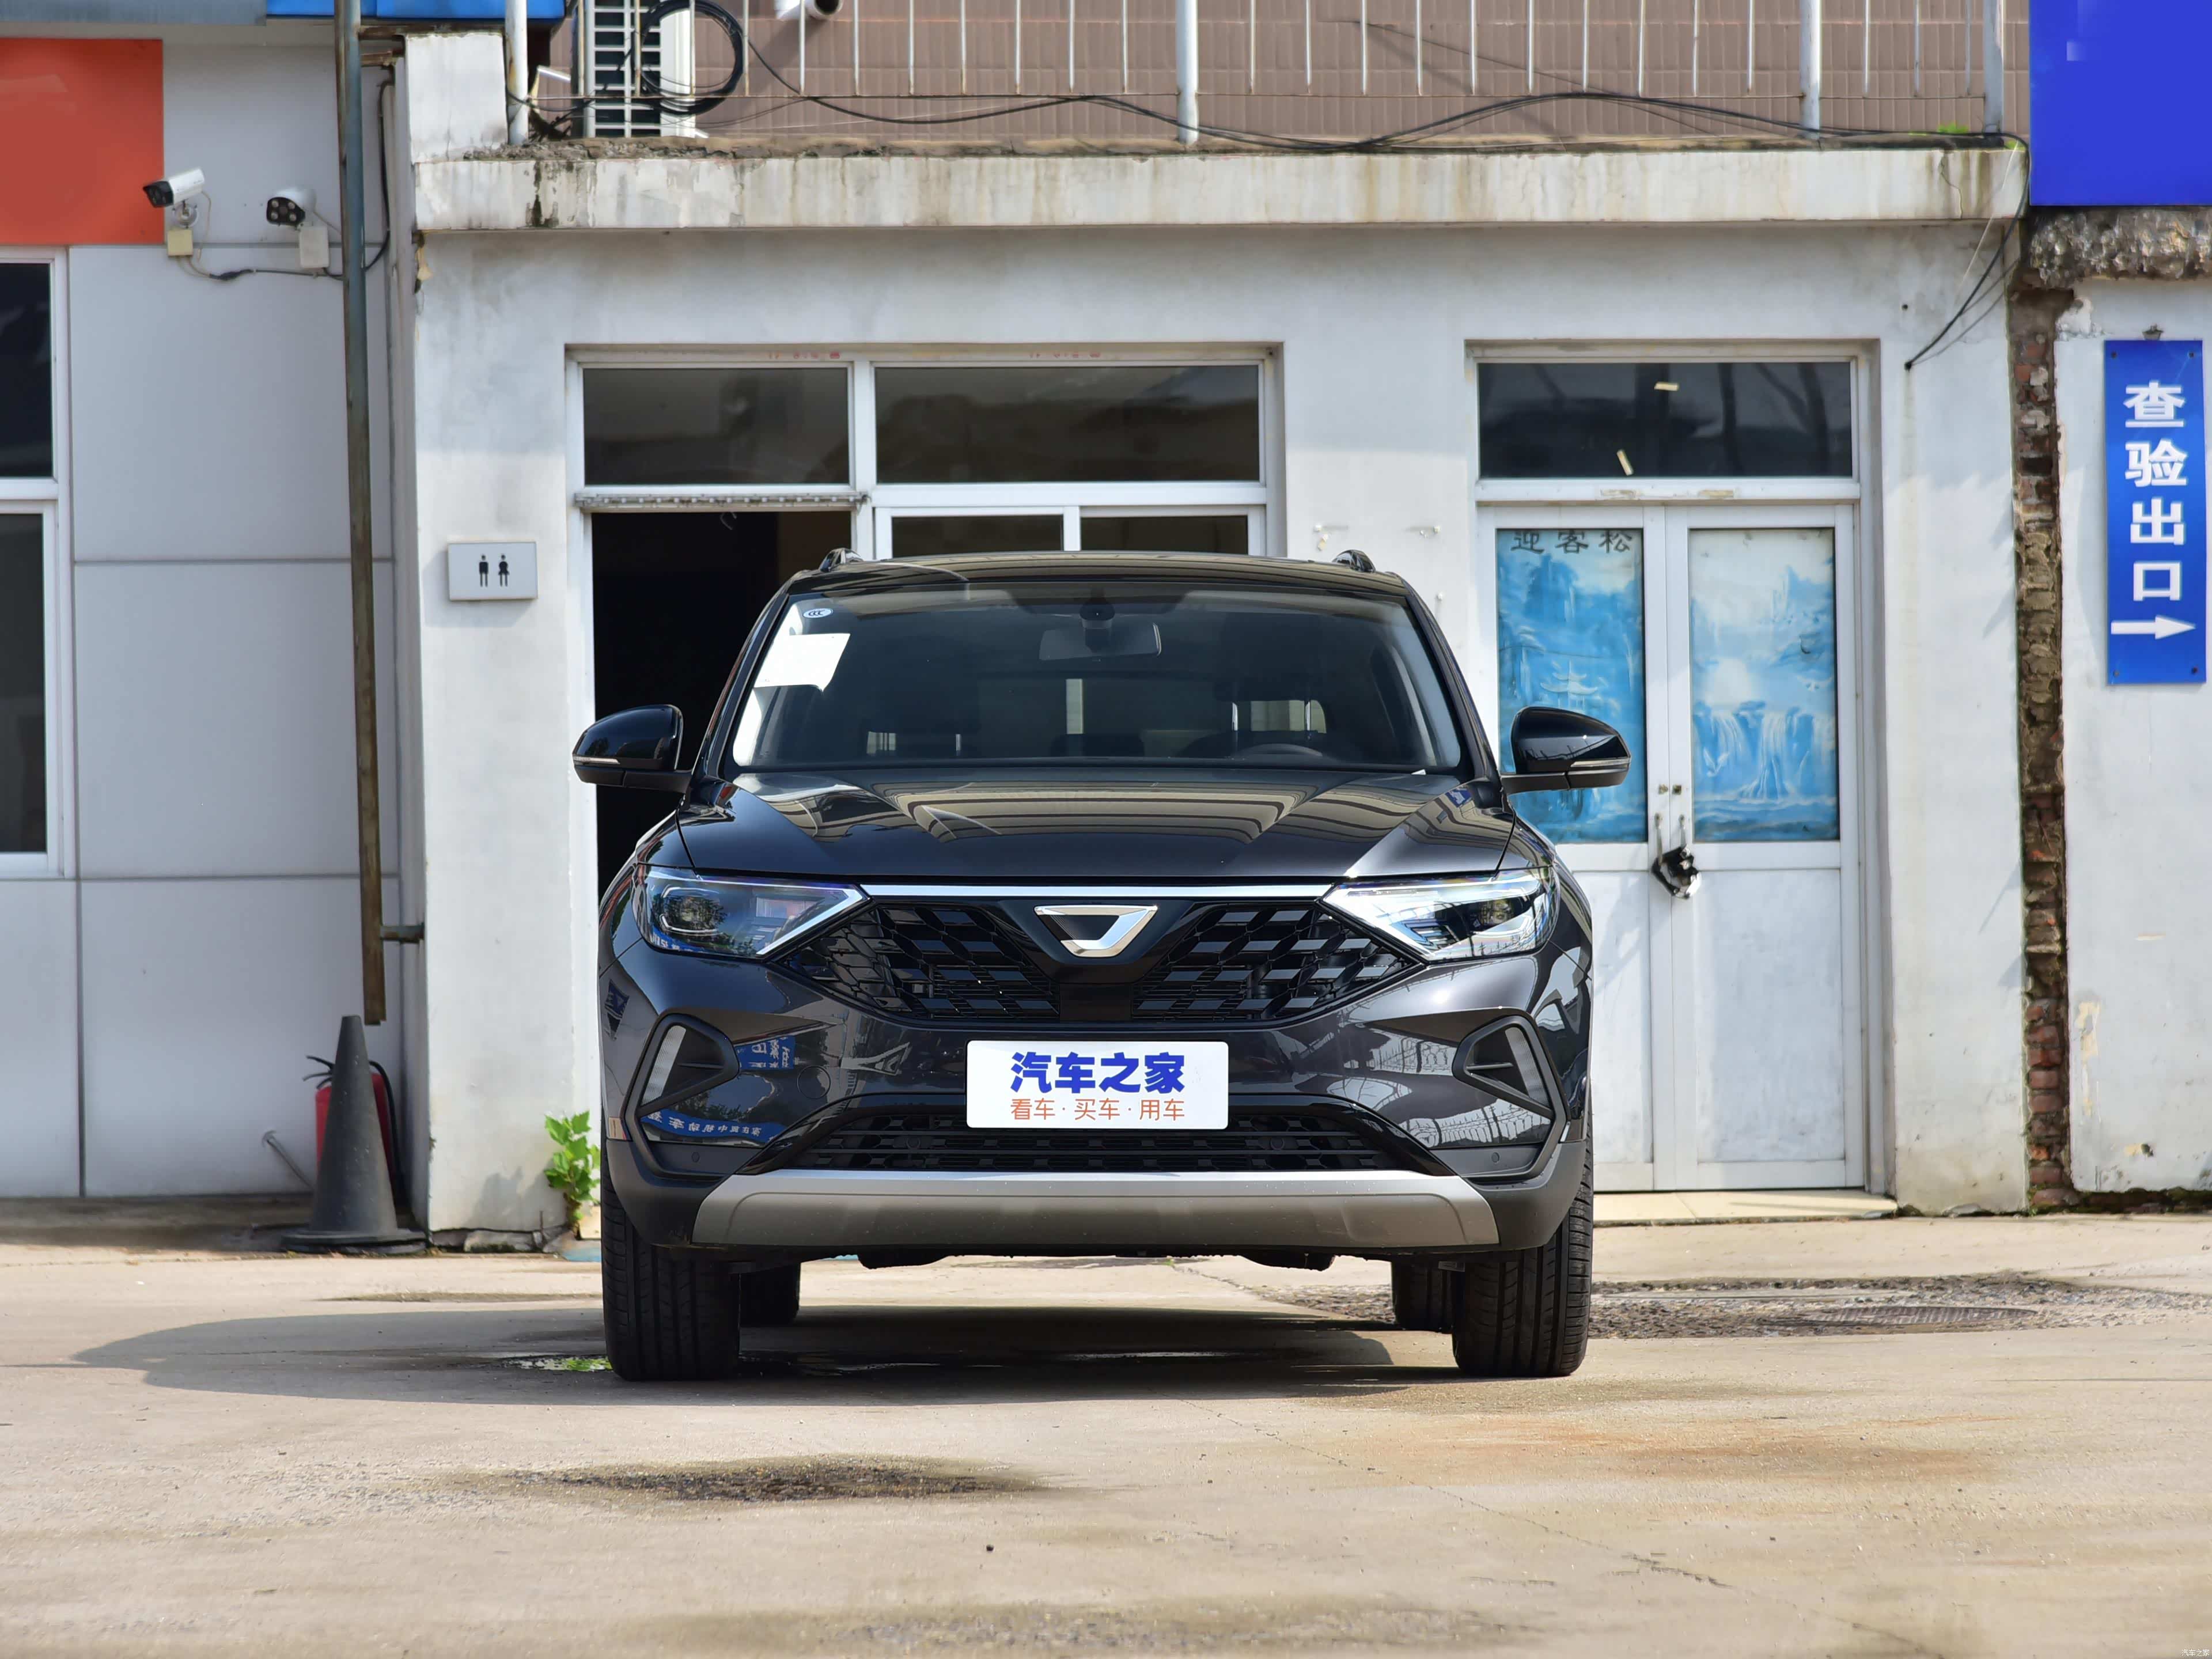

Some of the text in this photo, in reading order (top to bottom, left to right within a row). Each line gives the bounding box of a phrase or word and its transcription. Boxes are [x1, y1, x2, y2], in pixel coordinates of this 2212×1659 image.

[2123, 380, 2187, 601] 查验出口
[1510, 529, 1632, 554] 迎客松
[1010, 1051, 1185, 1094] 汽车之家
